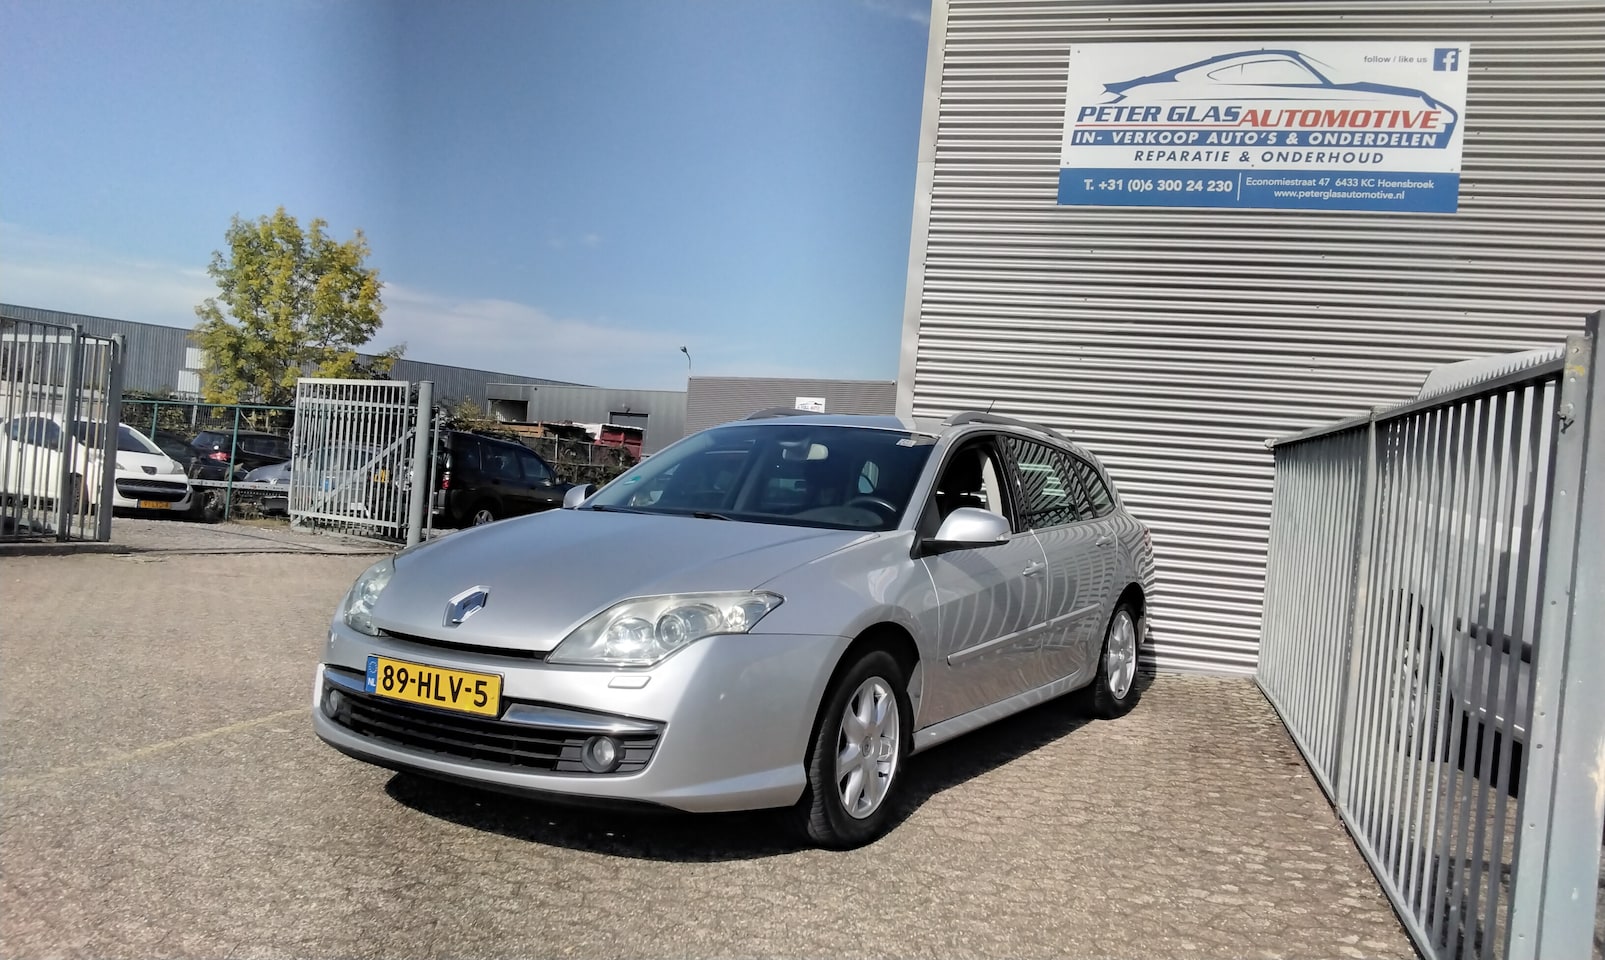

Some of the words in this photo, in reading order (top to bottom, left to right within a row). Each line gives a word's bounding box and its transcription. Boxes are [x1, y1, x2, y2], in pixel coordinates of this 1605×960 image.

[1363, 55, 1391, 63] follow
[1398, 55, 1414, 63] like
[1076, 106, 1162, 122] PETER
[1240, 109, 1441, 129] AUTOMOTIVE
[1075, 131, 1103, 144] IN-
[1112, 131, 1199, 144] VERKOOP
[1206, 132, 1277, 144] AUTO'S
[1286, 132, 1298, 145] &
[1308, 132, 1437, 147] ONDERDELEN
[1134, 150, 1230, 162] REPARATIE
[1238, 151, 1250, 162] &
[1261, 151, 1384, 164] ONDERHOUD
[1084, 179, 1094, 190] T.
[1098, 179, 1123, 190] +31
[1127, 179, 1153, 192] (0)6
[1157, 179, 1182, 191] 300
[1186, 180, 1203, 191] 24
[1207, 180, 1233, 192] 230
[1245, 177, 1316, 186] Economiestraat
[1318, 178, 1330, 186] 47
[1335, 178, 1359, 187] 6433
[1361, 179, 1375, 188] KC
[1378, 179, 1434, 189] Hoensbroek
[1274, 189, 1405, 200] www.peterglasautomotive.nl
[367, 677, 376, 687] NL
[382, 665, 488, 707] 89-HLV-5
